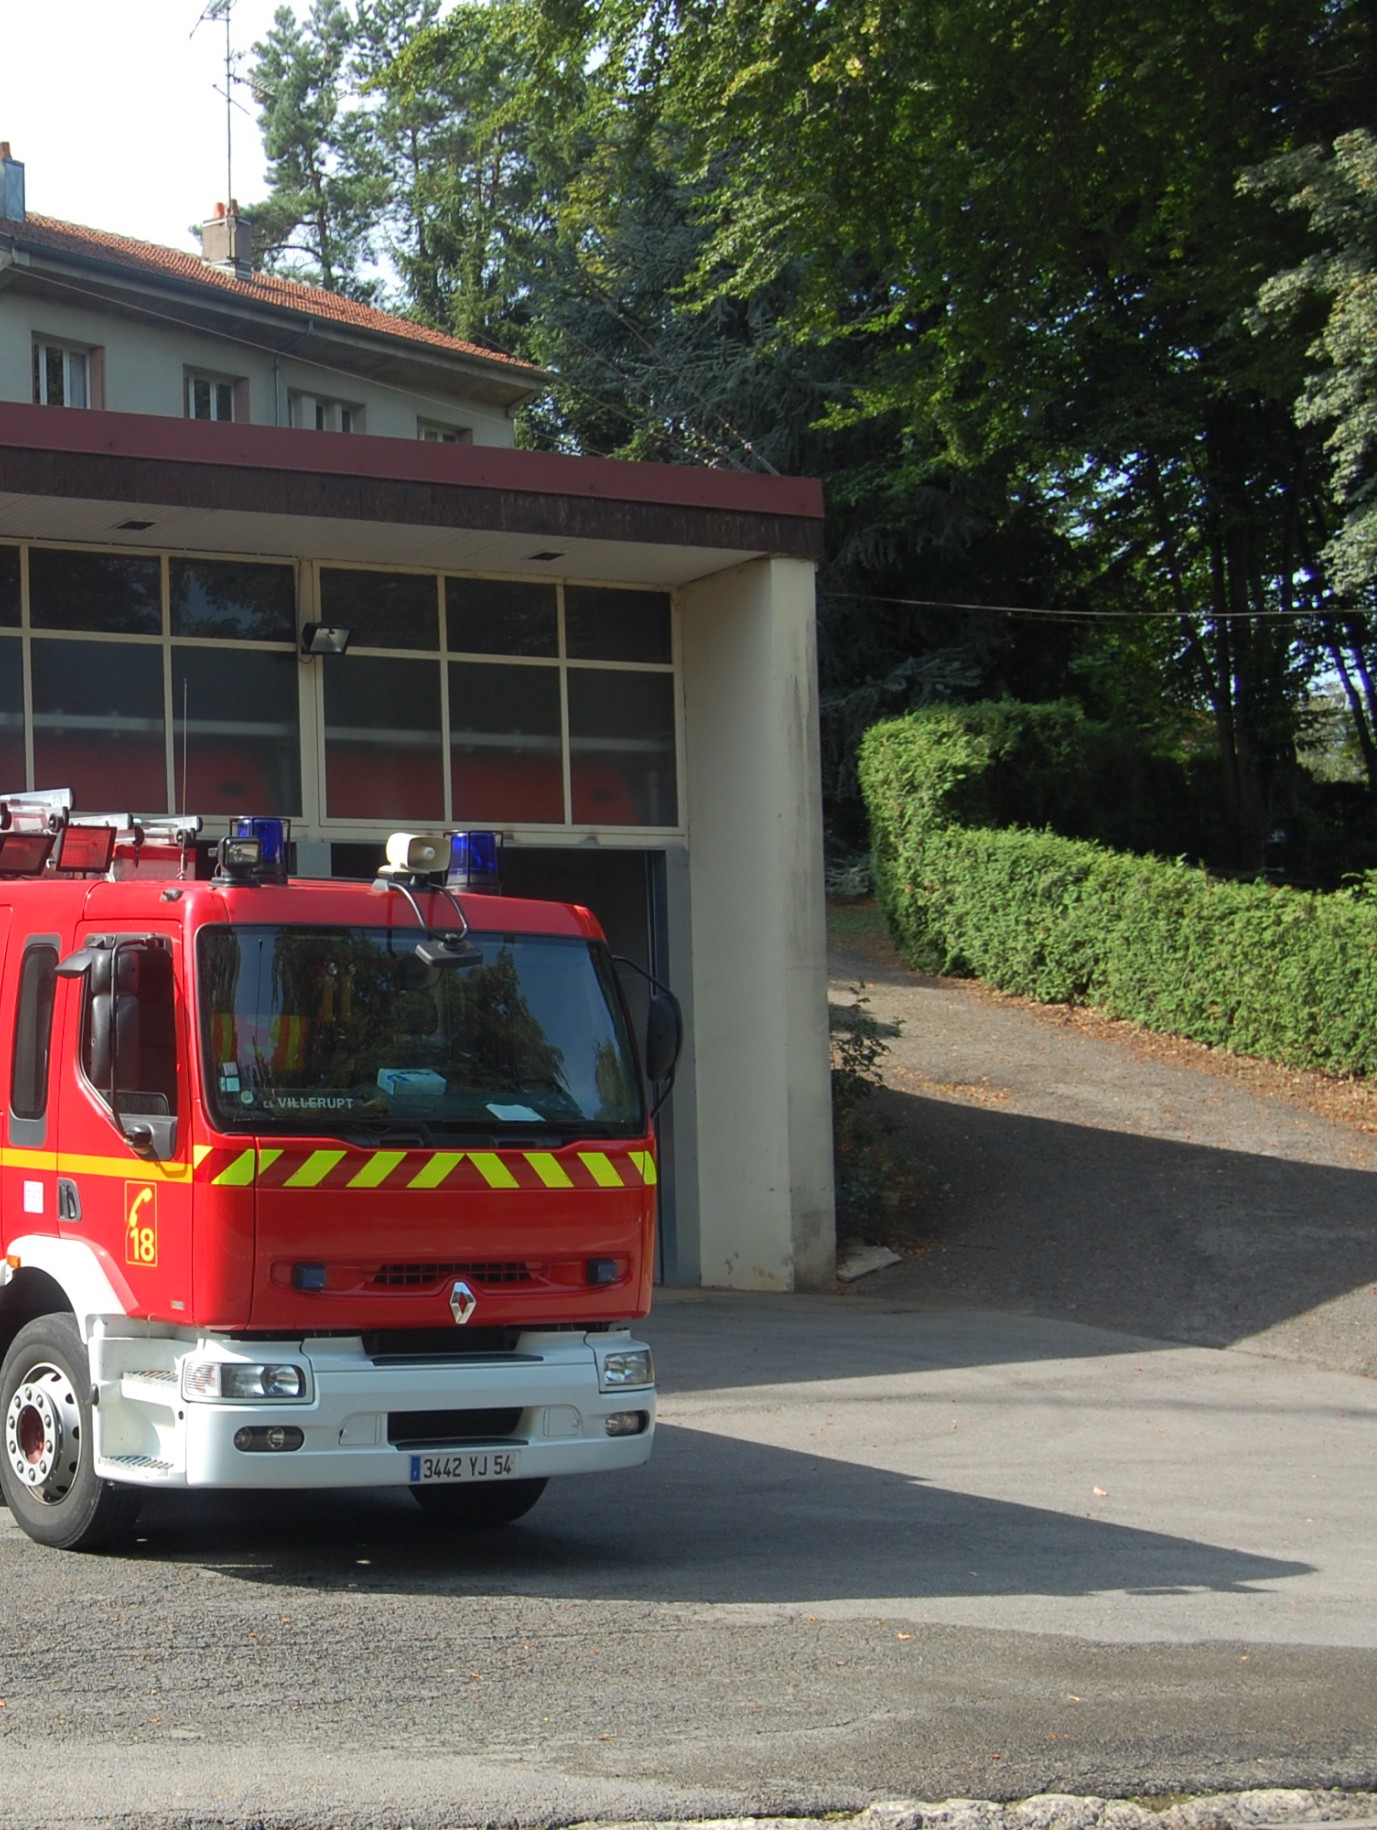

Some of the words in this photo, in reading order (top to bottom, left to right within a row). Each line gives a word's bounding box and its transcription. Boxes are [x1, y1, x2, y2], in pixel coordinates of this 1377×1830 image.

[277, 1097, 353, 1109] VILLERUPT
[130, 1227, 155, 1262] 18
[423, 1457, 462, 1479] 3442
[470, 1456, 487, 1476] YJ
[494, 1455, 511, 1475] 54
